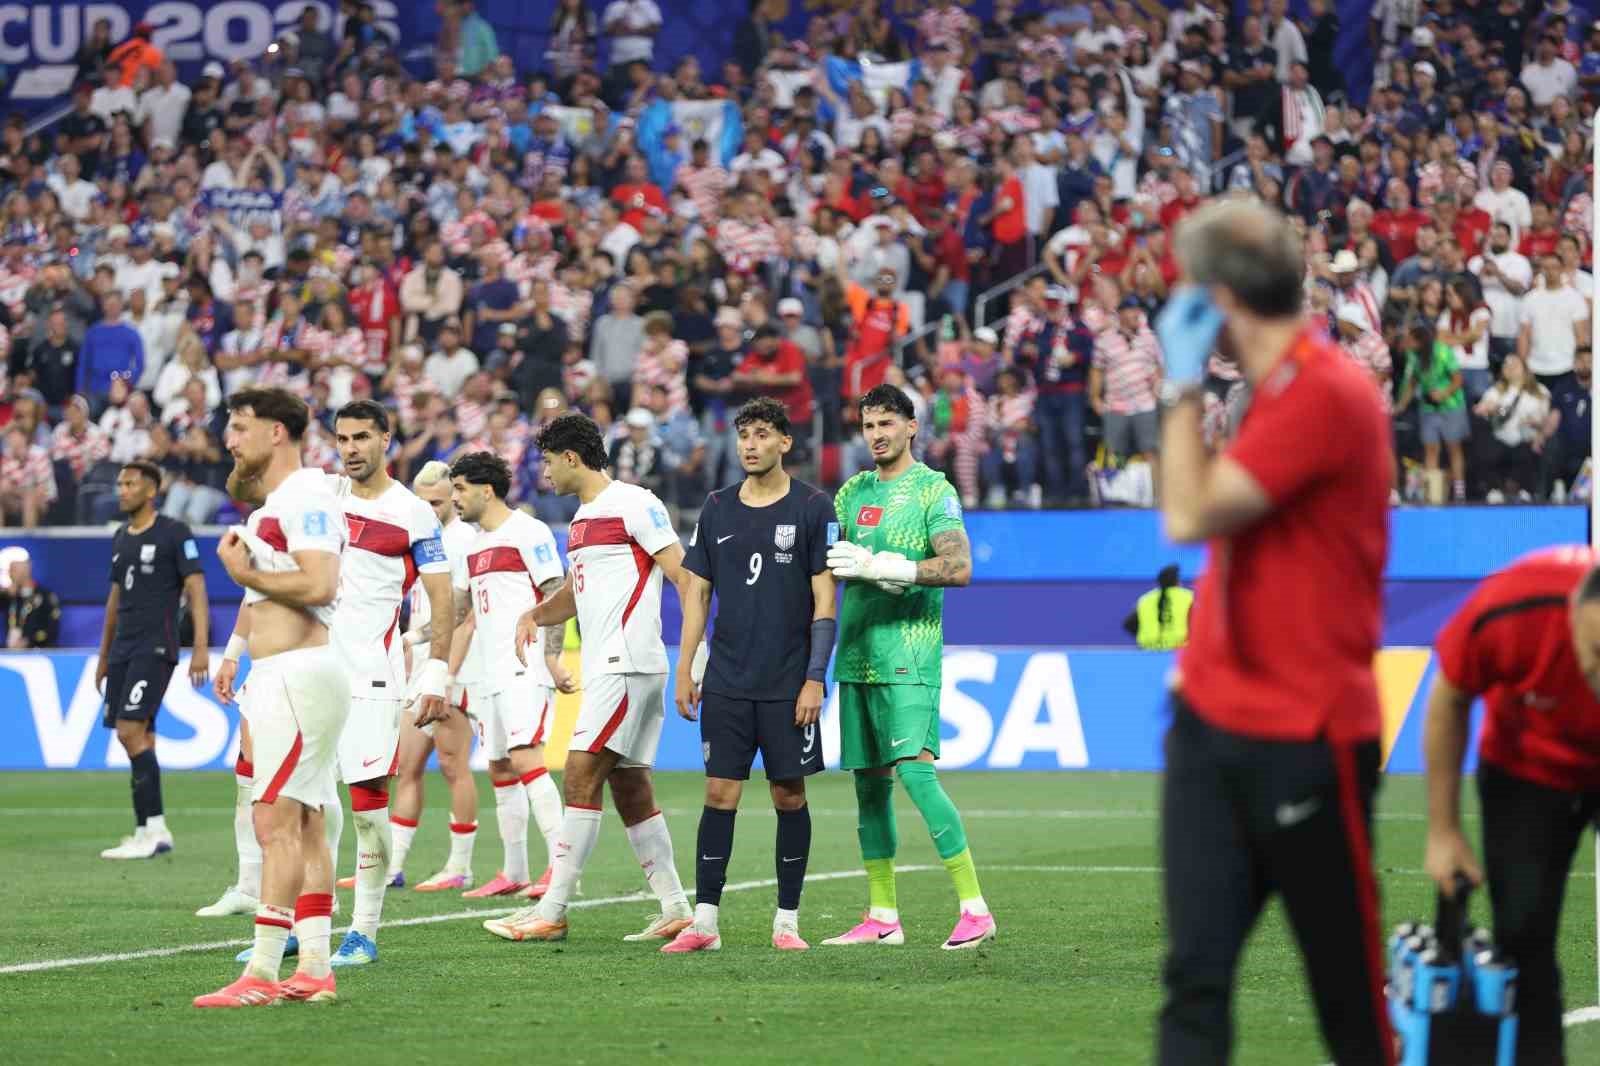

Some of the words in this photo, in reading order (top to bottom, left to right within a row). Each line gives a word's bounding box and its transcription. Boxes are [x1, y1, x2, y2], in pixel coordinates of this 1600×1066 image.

[125, 564, 135, 590] 6
[746, 552, 763, 585] 9
[477, 589, 489, 614] 13
[129, 679, 148, 705] 6
[0, 654, 241, 768] VS
[803, 723, 815, 753] 9
